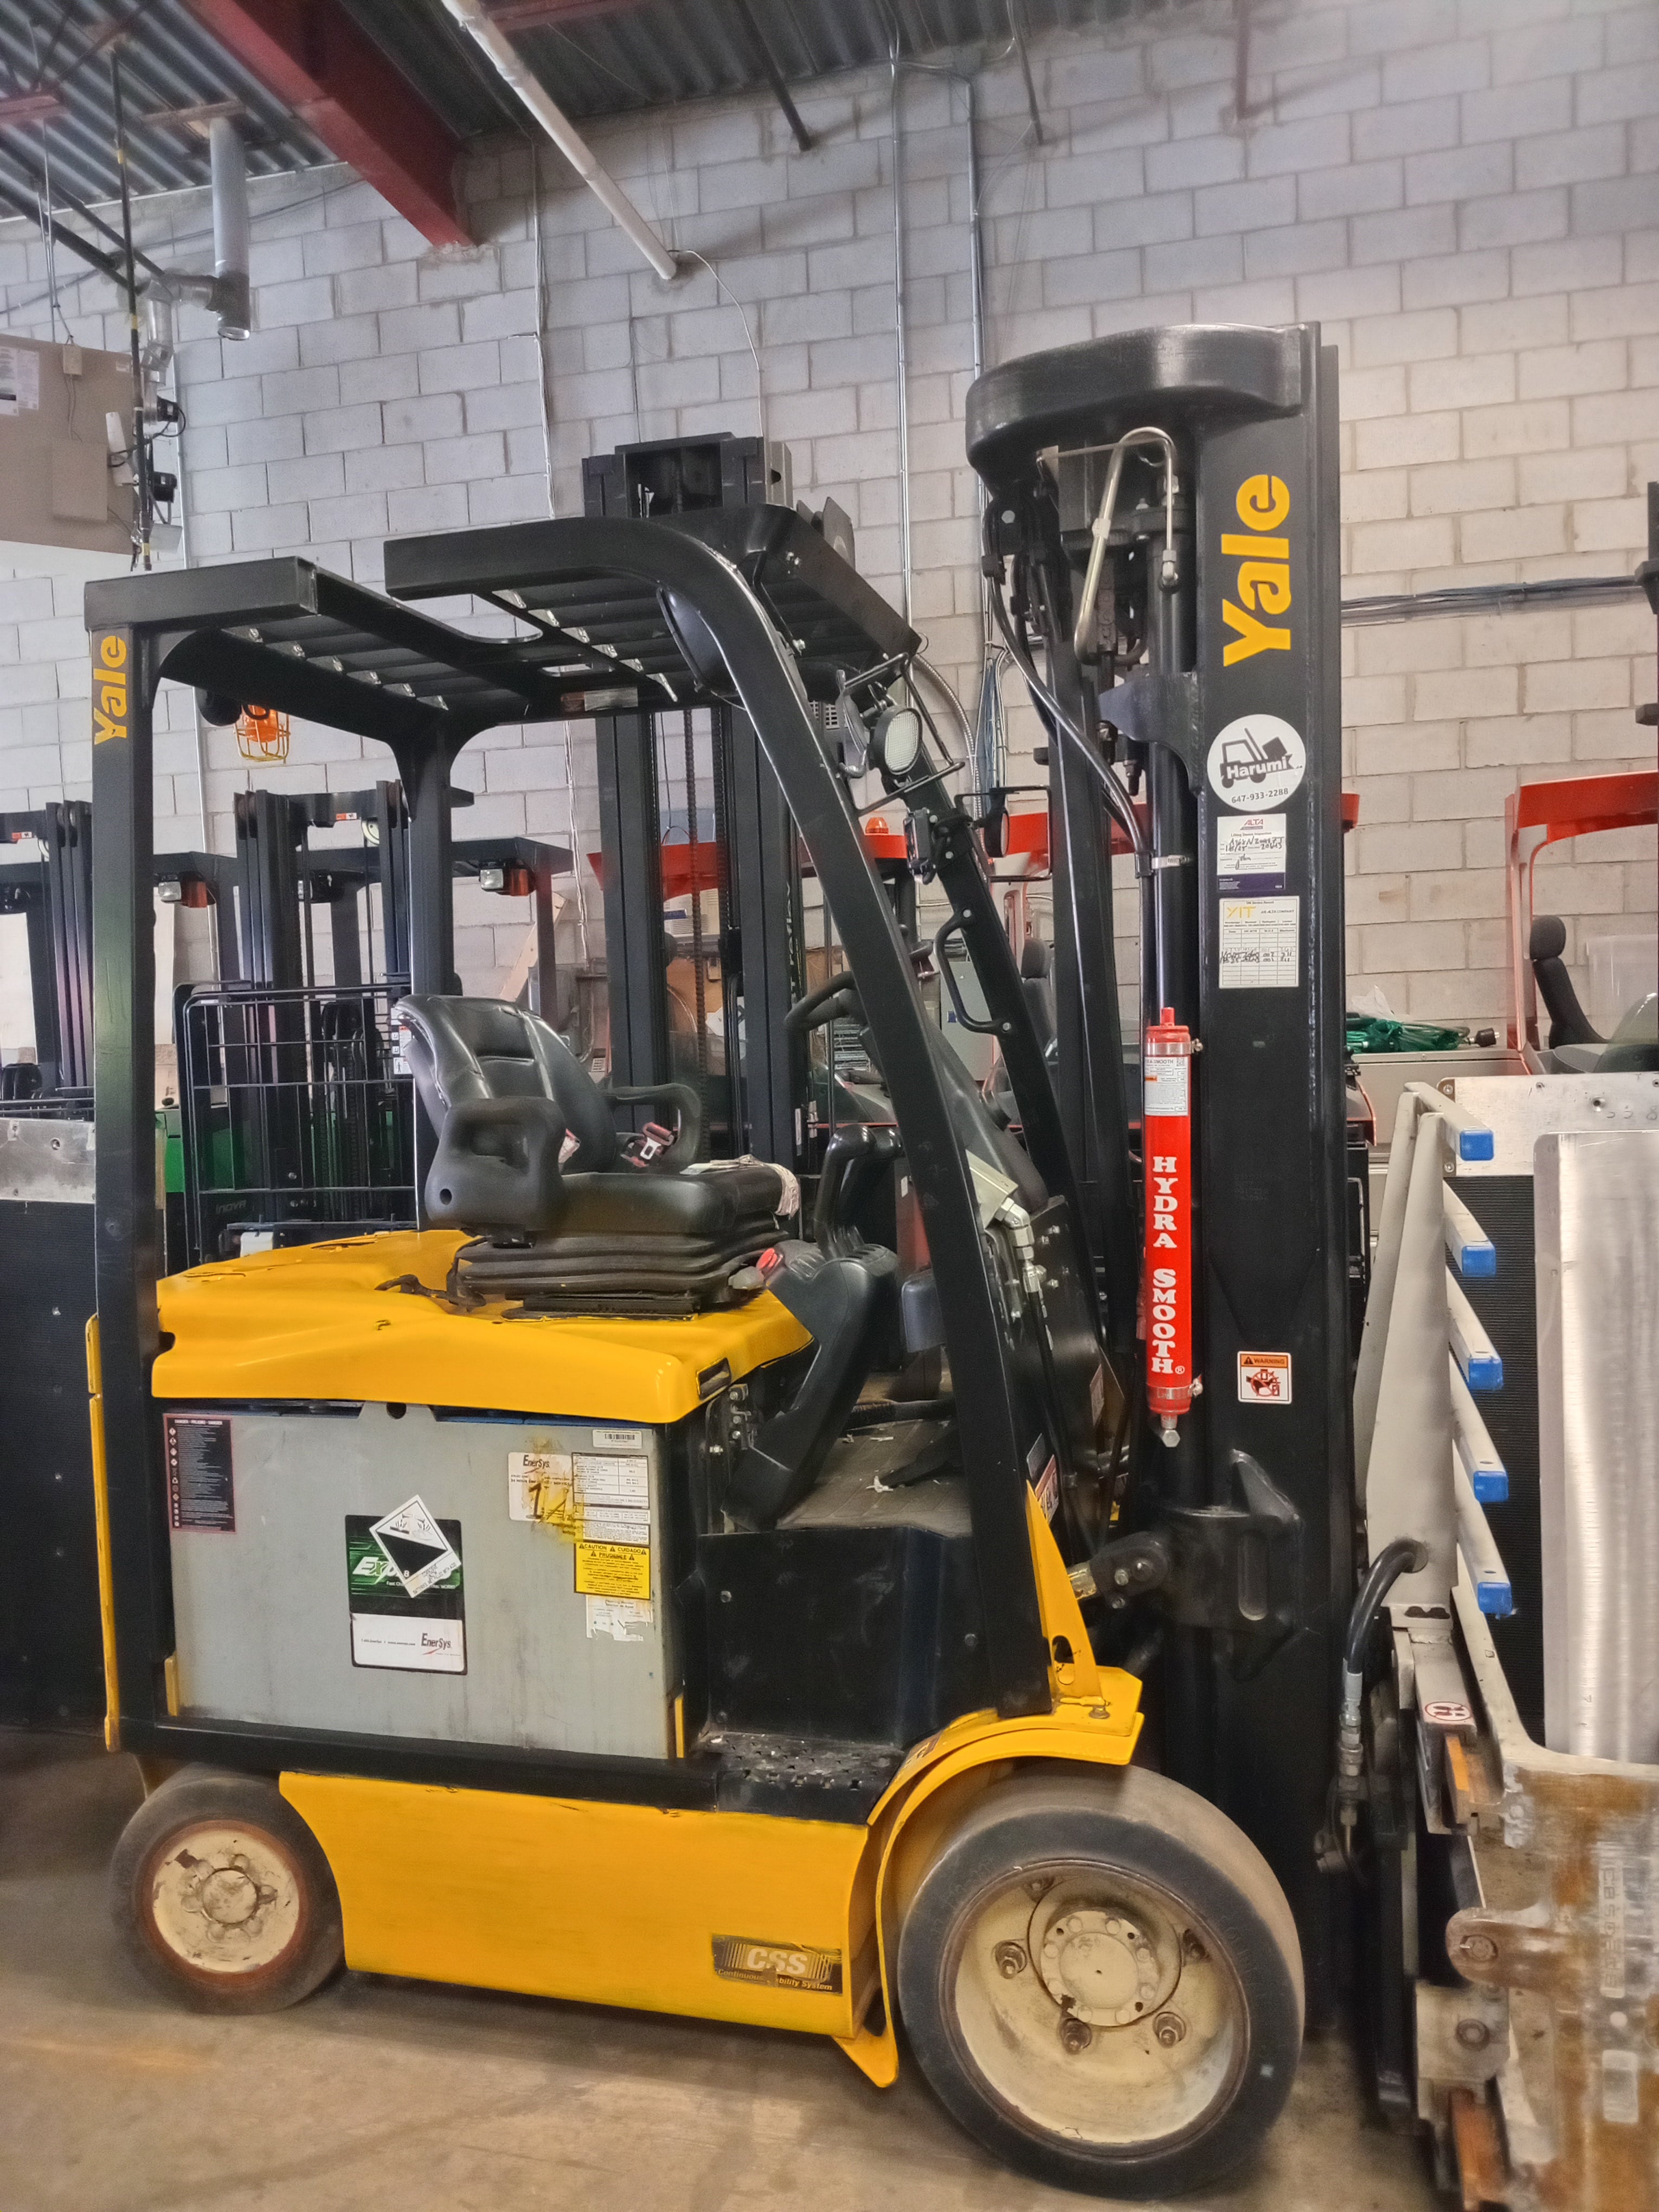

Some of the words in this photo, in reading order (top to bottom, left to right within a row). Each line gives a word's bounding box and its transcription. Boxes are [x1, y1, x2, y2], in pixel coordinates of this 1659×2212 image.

[1221, 474, 1291, 667] Yale
[93, 635, 127, 745] Yale
[1226, 756, 1288, 780] Harumi
[1231, 788, 1289, 803] 647-933-2288
[1227, 906, 1256, 918] YIT
[1152, 1156, 1179, 1249] HYDRA
[523, 1454, 550, 1469] EnerSys
[421, 1632, 452, 1650] EnerSys
[747, 1947, 808, 1975] CSS
[779, 1978, 800, 1987] bility
[801, 1980, 833, 1991] System
